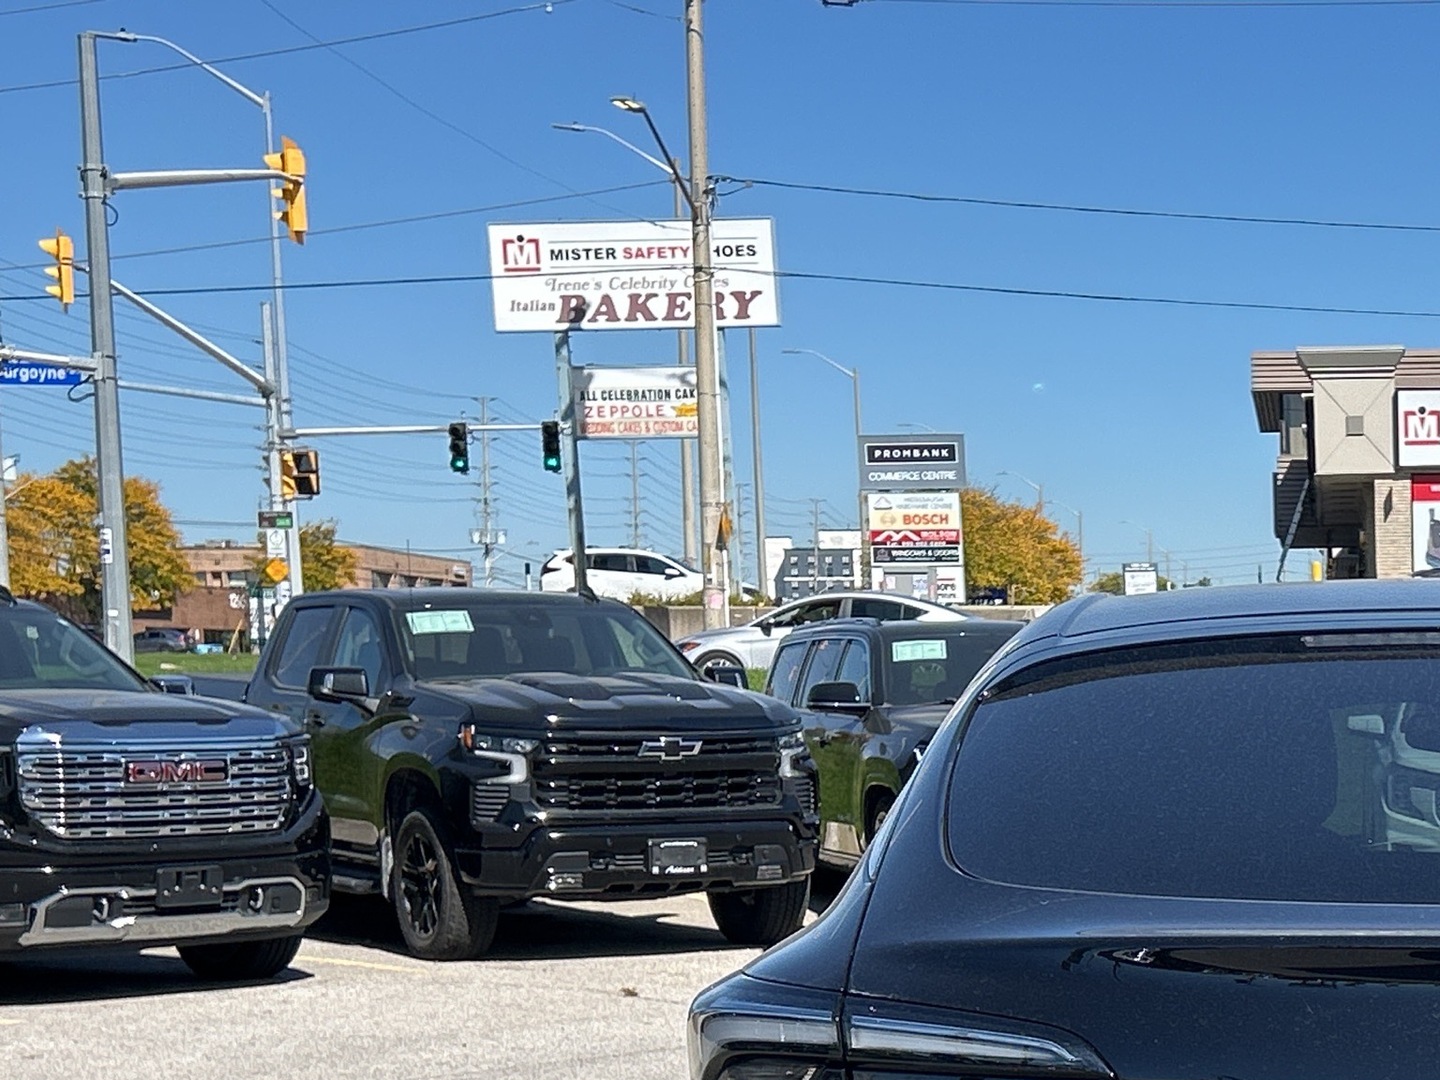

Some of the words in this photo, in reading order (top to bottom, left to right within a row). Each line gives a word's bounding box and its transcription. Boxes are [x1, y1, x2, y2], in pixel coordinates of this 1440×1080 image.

[550, 247, 617, 261] MISTER
[622, 246, 690, 259] SAFETY
[713, 244, 757, 257] HOES
[544, 278, 602, 292] Irene's
[608, 275, 678, 291] Celebrity
[683, 275, 729, 289] Ces
[510, 300, 556, 312] Italian
[0, 367, 67, 383] urgoyne
[580, 390, 597, 402] ALL
[601, 388, 671, 401] CELEBRATION
[584, 404, 665, 418] ZEPPOLE
[868, 472, 920, 481] COMMERCE
[921, 471, 957, 480] CENTRE
[903, 514, 949, 525] BOSCH
[128, 761, 226, 782] GMC
